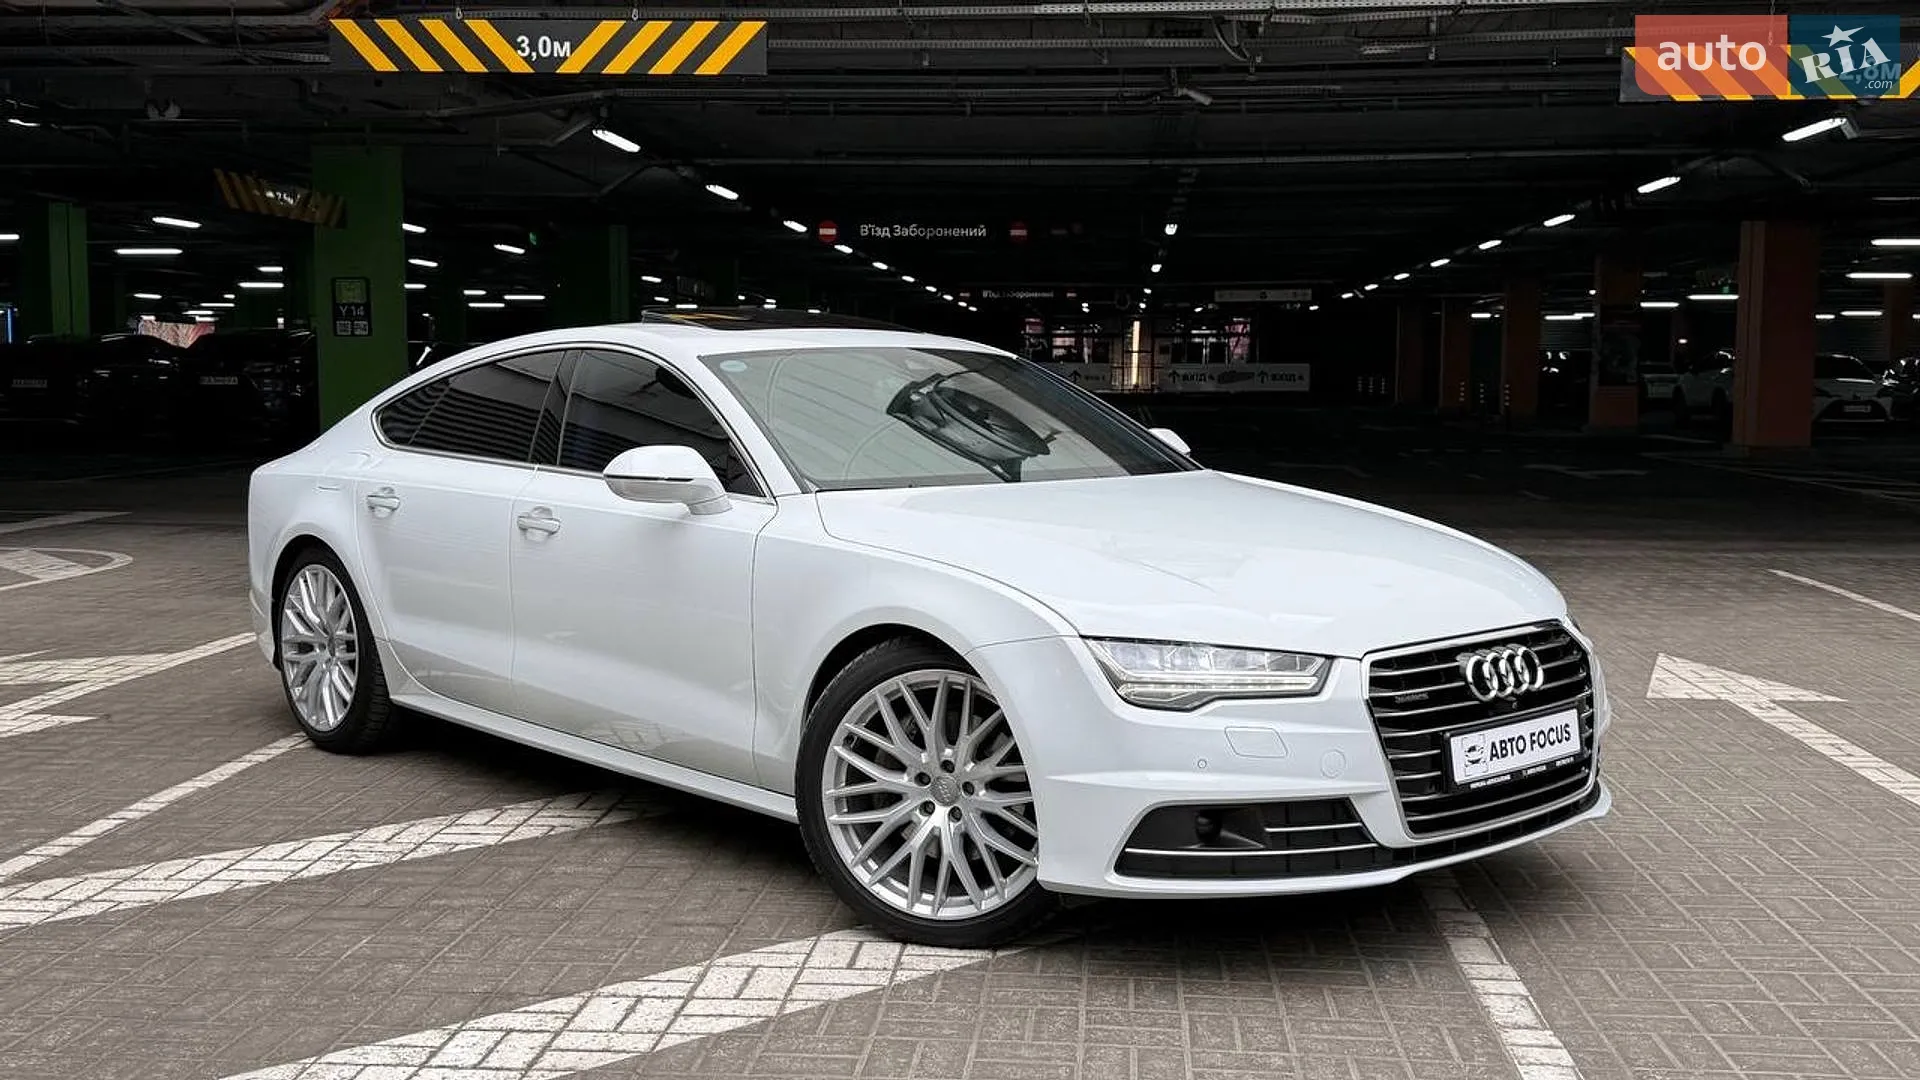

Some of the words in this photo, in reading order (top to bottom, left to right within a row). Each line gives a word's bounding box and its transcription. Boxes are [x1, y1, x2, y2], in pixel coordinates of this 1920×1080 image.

[516, 35, 571, 61] 3,0м
[892, 224, 987, 240] Заборонений
[1489, 735, 1526, 761] АВТО
[1529, 723, 1571, 751] FOCUS
